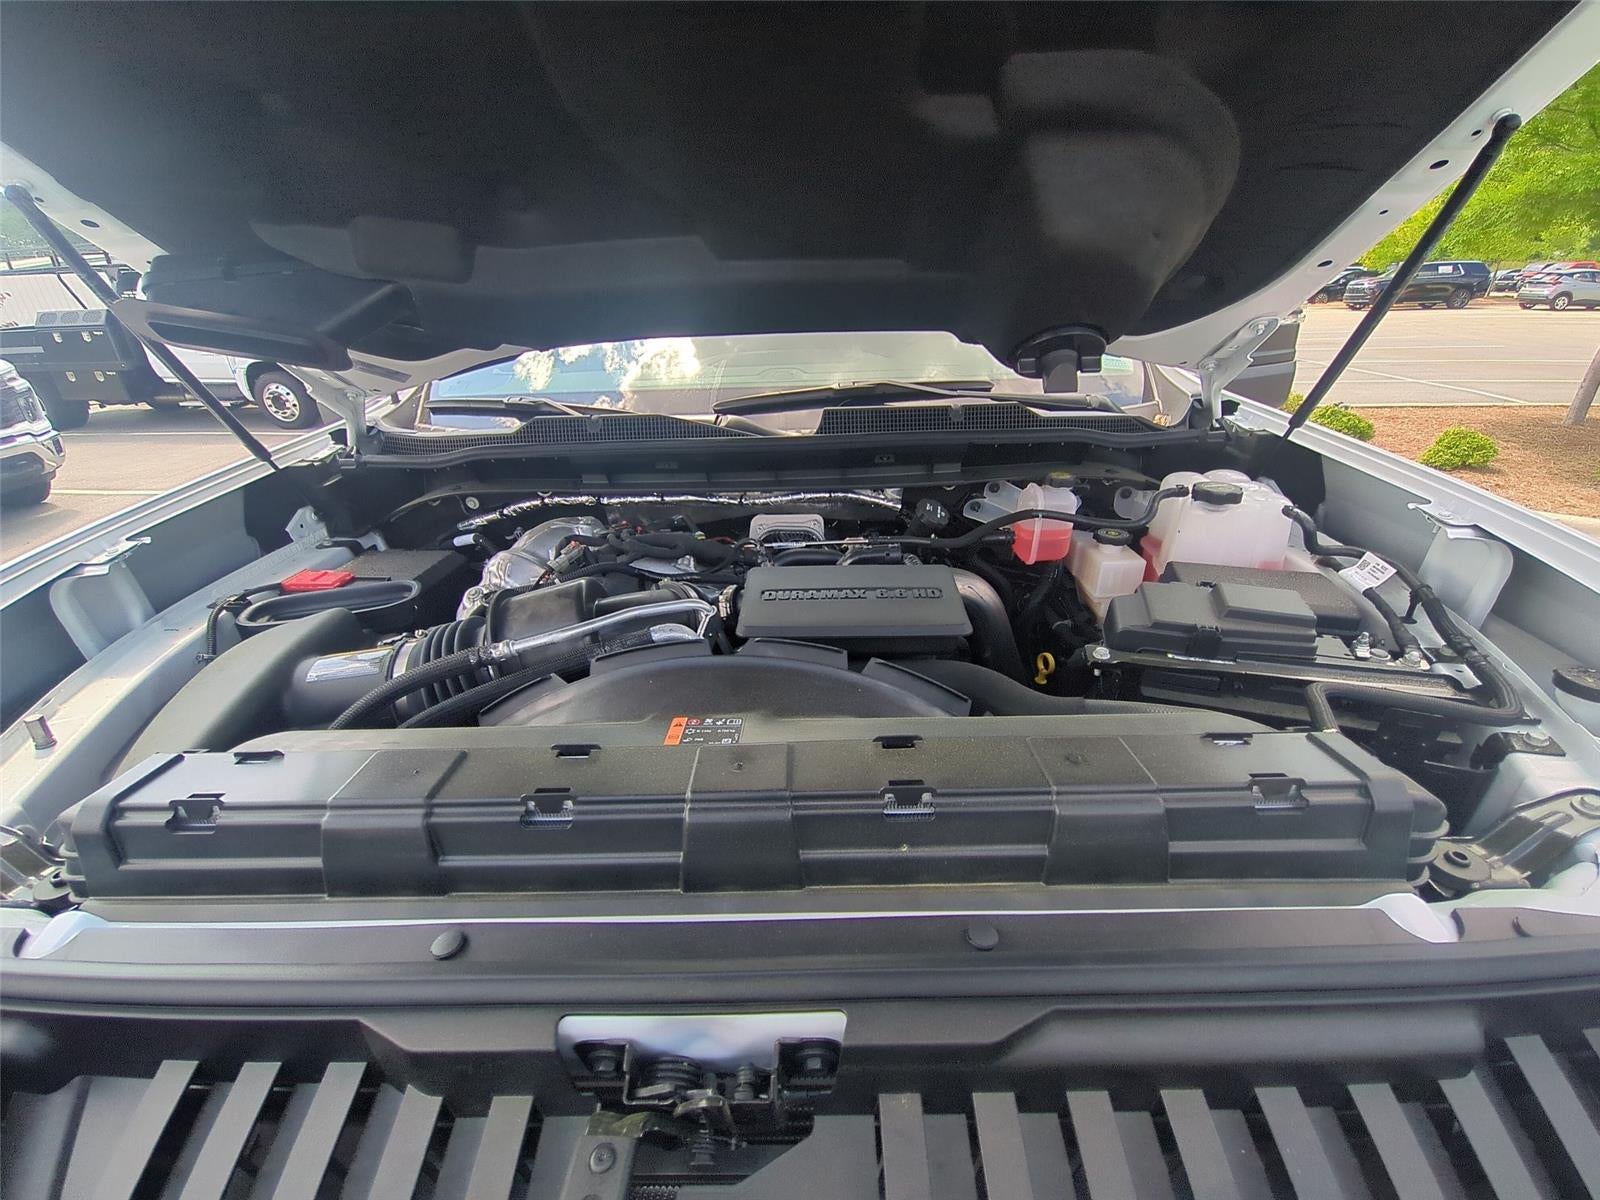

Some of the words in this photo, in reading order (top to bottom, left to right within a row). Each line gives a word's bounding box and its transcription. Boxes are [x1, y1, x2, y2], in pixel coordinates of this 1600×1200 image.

[761, 588, 868, 601] DURAMAX
[875, 588, 908, 599] 6.6
[912, 588, 943, 599] HD
